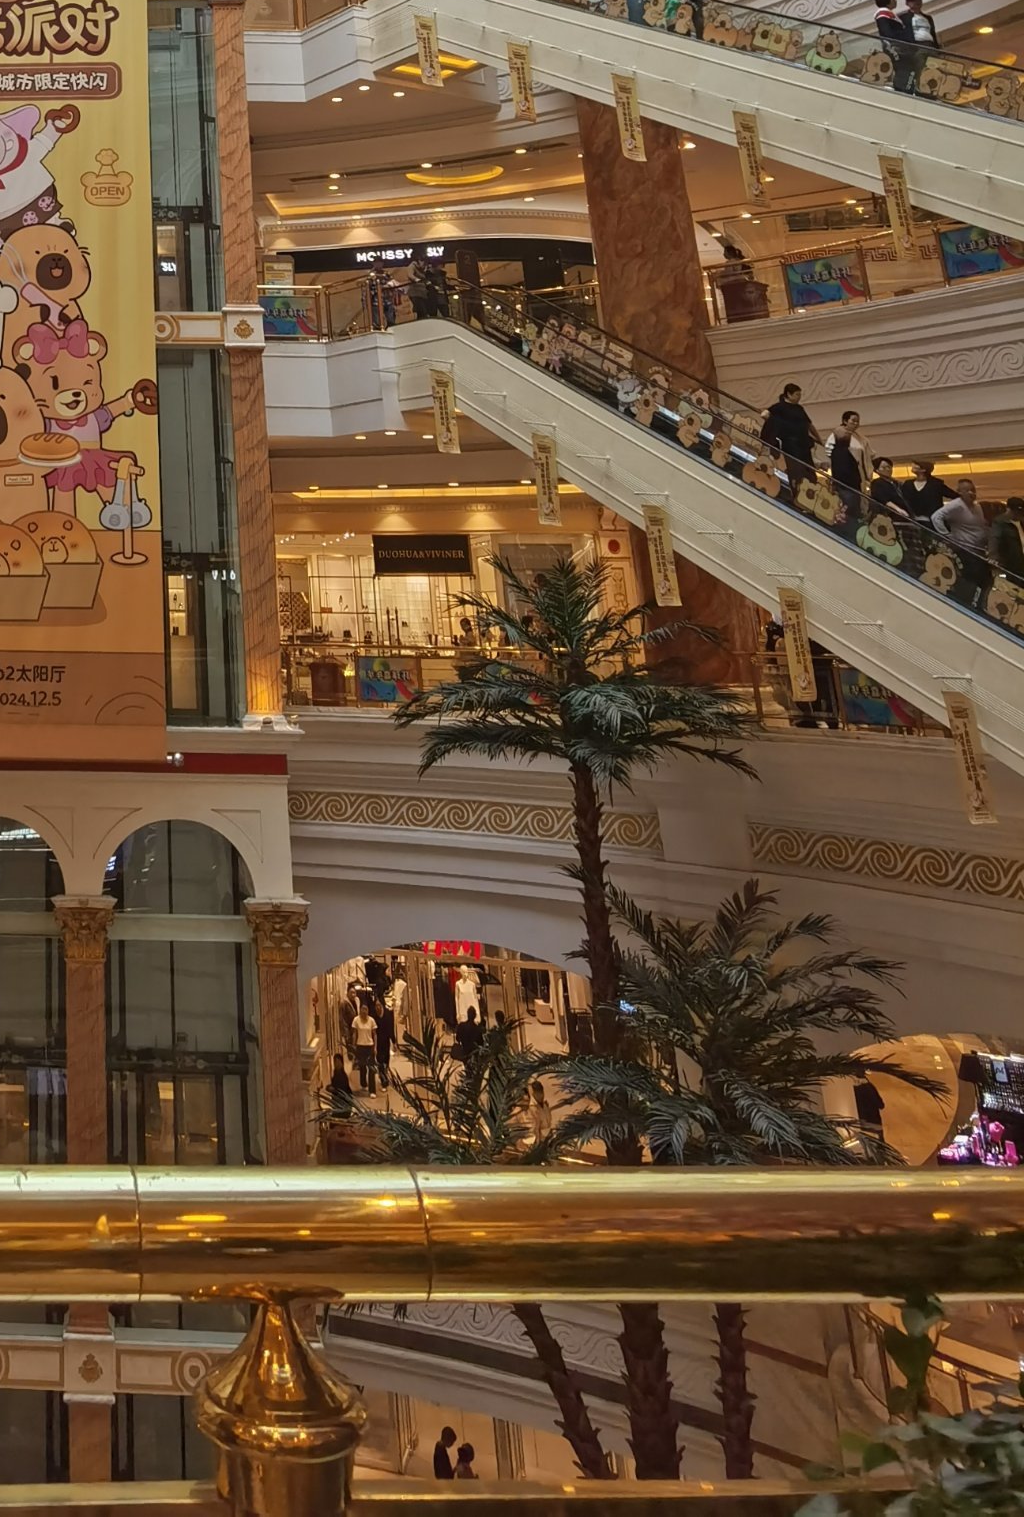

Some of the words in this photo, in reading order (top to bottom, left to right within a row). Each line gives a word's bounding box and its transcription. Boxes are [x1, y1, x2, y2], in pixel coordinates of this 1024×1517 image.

[90, 186, 125, 196] OPEN
[426, 246, 445, 258] SLY
[378, 549, 465, 560] DUOHUA&VIVINER
